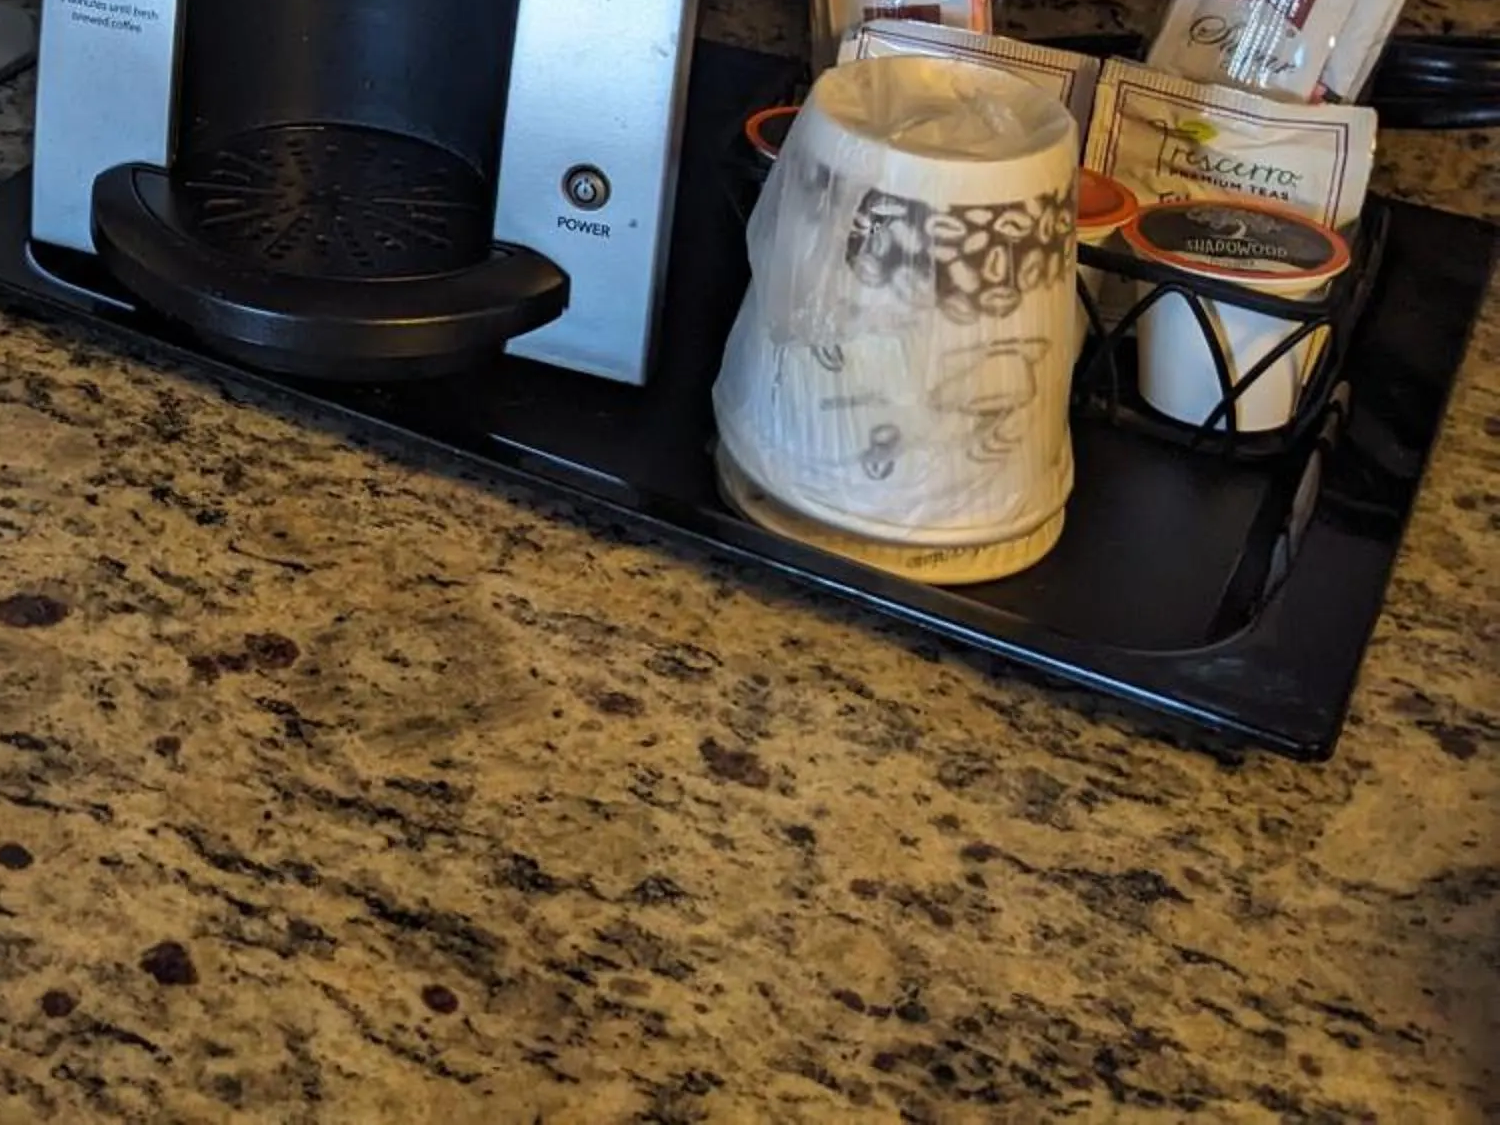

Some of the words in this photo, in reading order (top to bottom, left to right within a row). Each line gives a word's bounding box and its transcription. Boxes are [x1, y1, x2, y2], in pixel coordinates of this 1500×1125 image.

[1249, 184, 1290, 202] TEAS
[557, 216, 611, 238] POWER
[1186, 237, 1289, 259] SHADOWOOD
